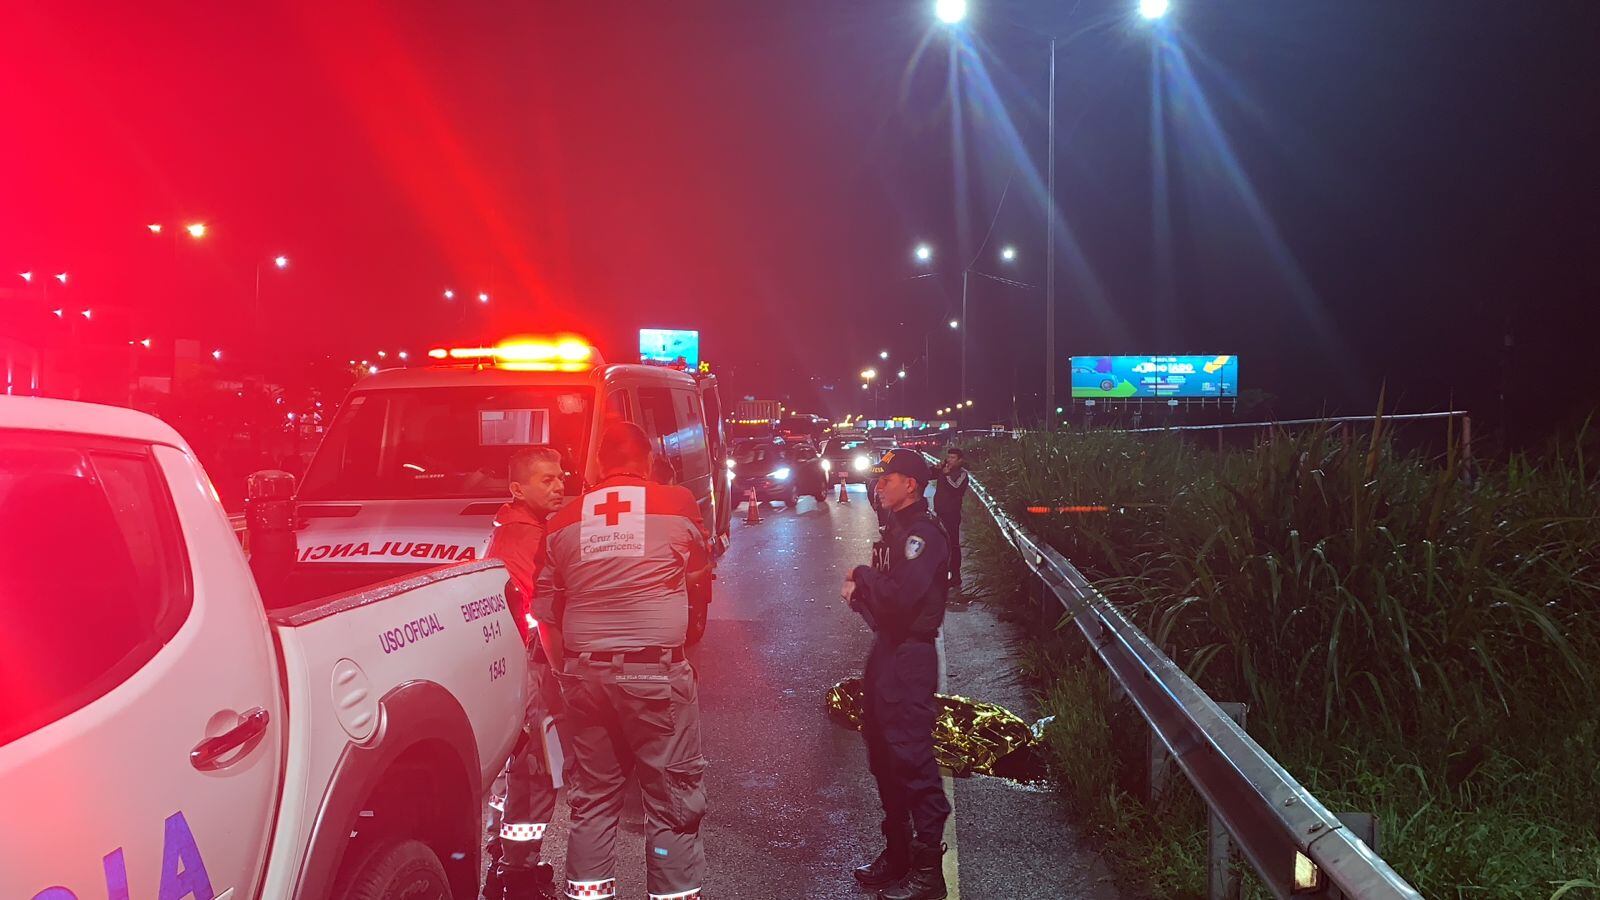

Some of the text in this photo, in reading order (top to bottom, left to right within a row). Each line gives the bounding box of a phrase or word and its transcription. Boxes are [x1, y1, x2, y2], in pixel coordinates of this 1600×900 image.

[583, 541, 642, 554] Costarricense
[589, 531, 634, 543] Cruz Roja
[460, 593, 506, 623] EMERGENCIAS
[379, 613, 445, 654] USO OFICIAL
[482, 620, 502, 643] 9-1-1
[489, 657, 506, 682] 1543
